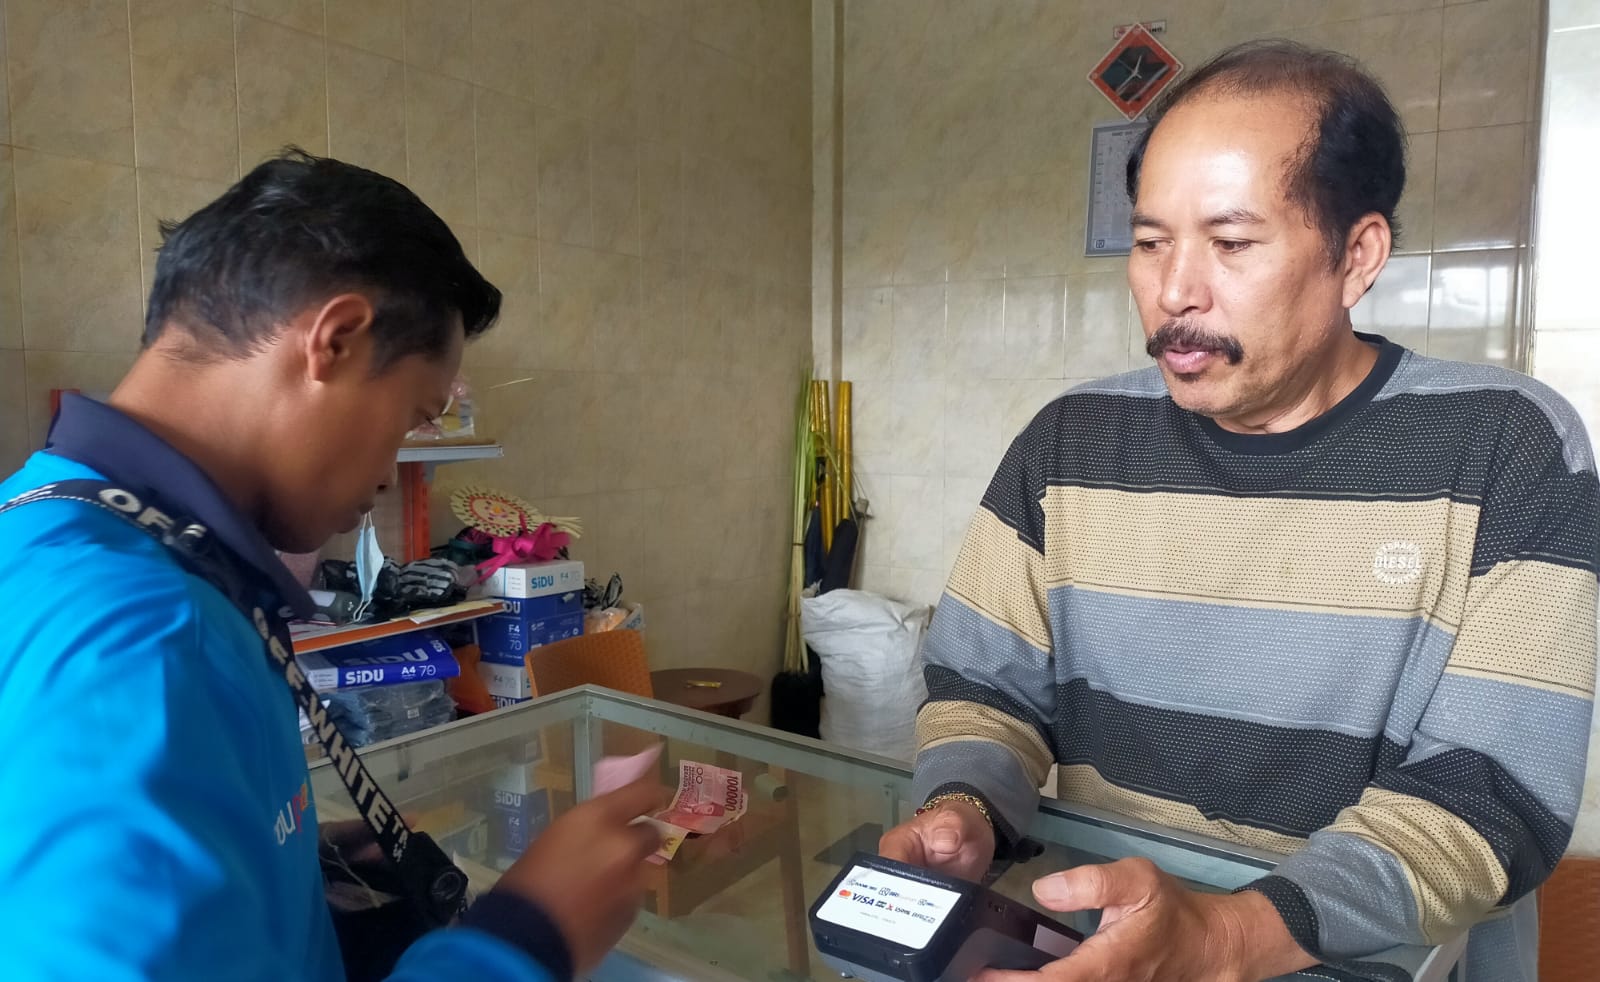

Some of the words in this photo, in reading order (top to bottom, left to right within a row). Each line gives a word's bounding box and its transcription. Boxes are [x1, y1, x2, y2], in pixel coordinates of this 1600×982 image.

[1374, 555, 1422, 569] DIESEL
[531, 575, 554, 590] SiDU
[508, 624, 520, 633] F4
[509, 640, 522, 651] 70
[345, 669, 384, 685] SiDU
[401, 666, 416, 675] A4
[725, 776, 738, 811] 100000
[852, 892, 875, 906] VISA
